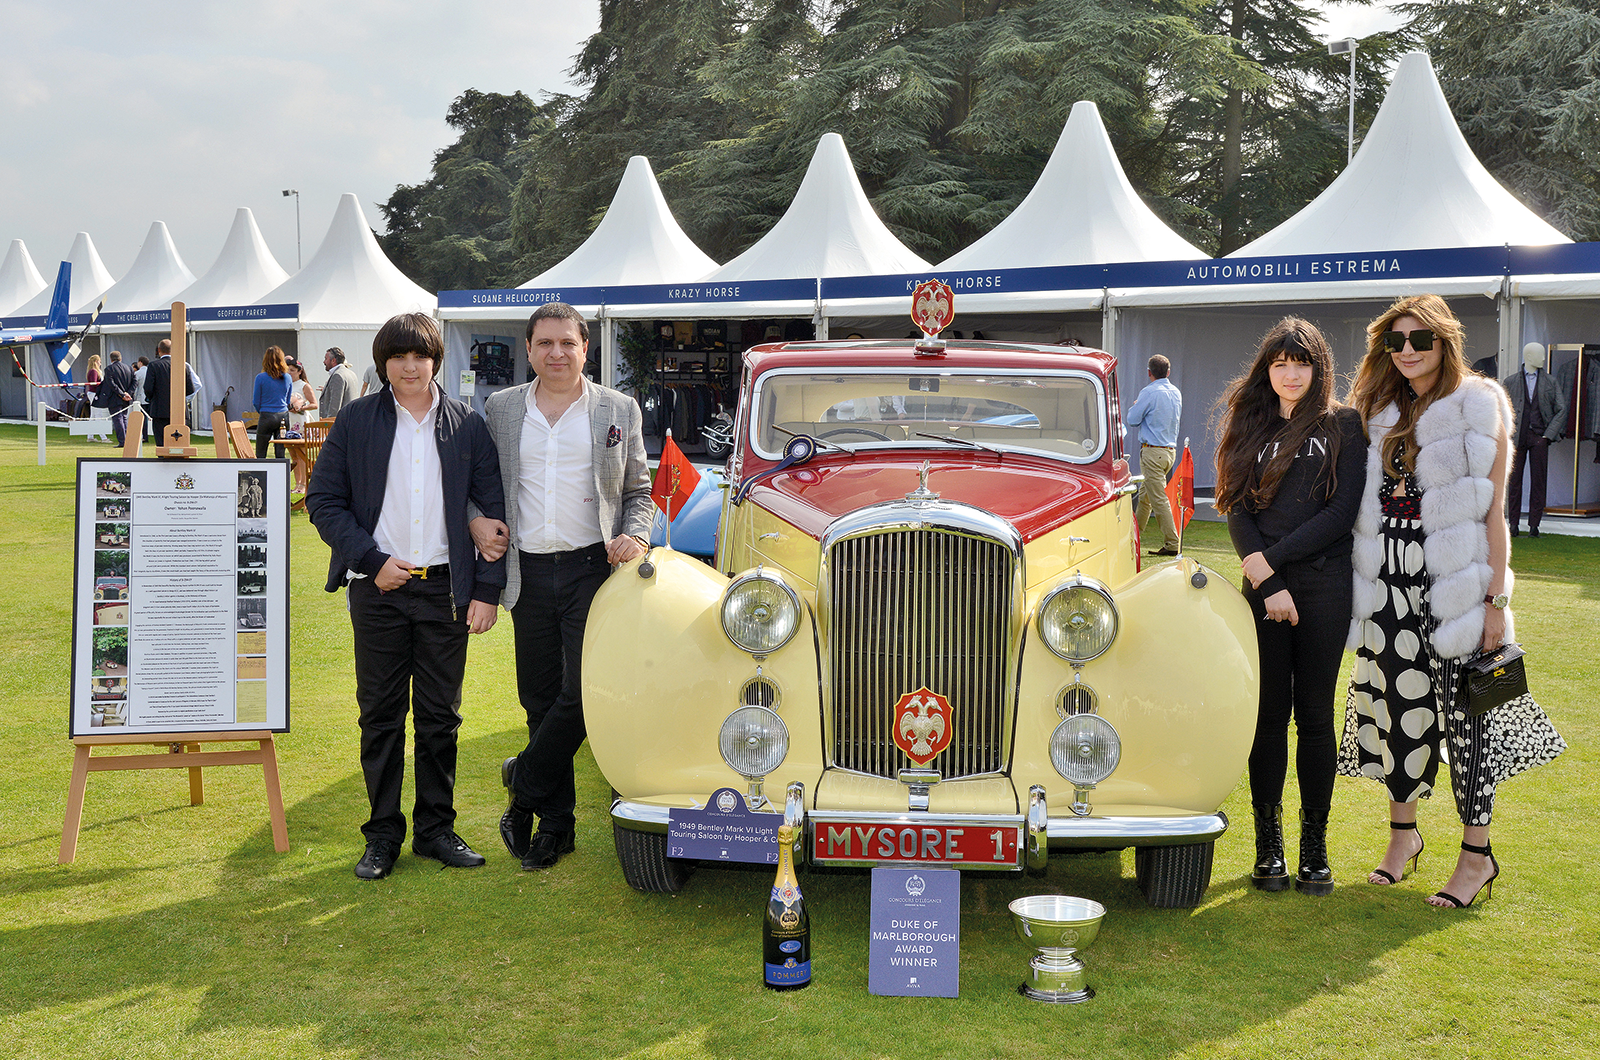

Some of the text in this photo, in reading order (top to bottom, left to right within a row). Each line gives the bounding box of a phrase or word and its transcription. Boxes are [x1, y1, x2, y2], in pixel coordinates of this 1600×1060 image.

[1187, 257, 1401, 280] AUTOMOBILI ESTREMA
[906, 276, 1002, 290] KRY HORSE
[668, 286, 740, 299] KRAZY HORSE
[472, 292, 562, 304] SLOANE HELICOPTERS
[127, 314, 149, 322] CREATIVE
[149, 313, 169, 321] STATION
[217, 308, 268, 318] GEOFFERY PARKER
[679, 822, 696, 830] 1949
[698, 823, 724, 833] Bentley
[726, 825, 744, 833] Mark
[755, 826, 773, 836] Light
[670, 830, 696, 839] Touring
[698, 832, 722, 840] Saloon
[724, 833, 733, 841] by
[735, 834, 761, 843] Hooper
[827, 826, 1005, 860] MYSORE 1
[671, 846, 684, 857] F2
[766, 852, 779, 862] F2
[891, 920, 938, 929] DUKE OF
[873, 932, 956, 942] MARLBOROUGH
[894, 944, 933, 954] AWARD
[890, 957, 938, 967] WINNER
[772, 970, 807, 980] POMMERY
